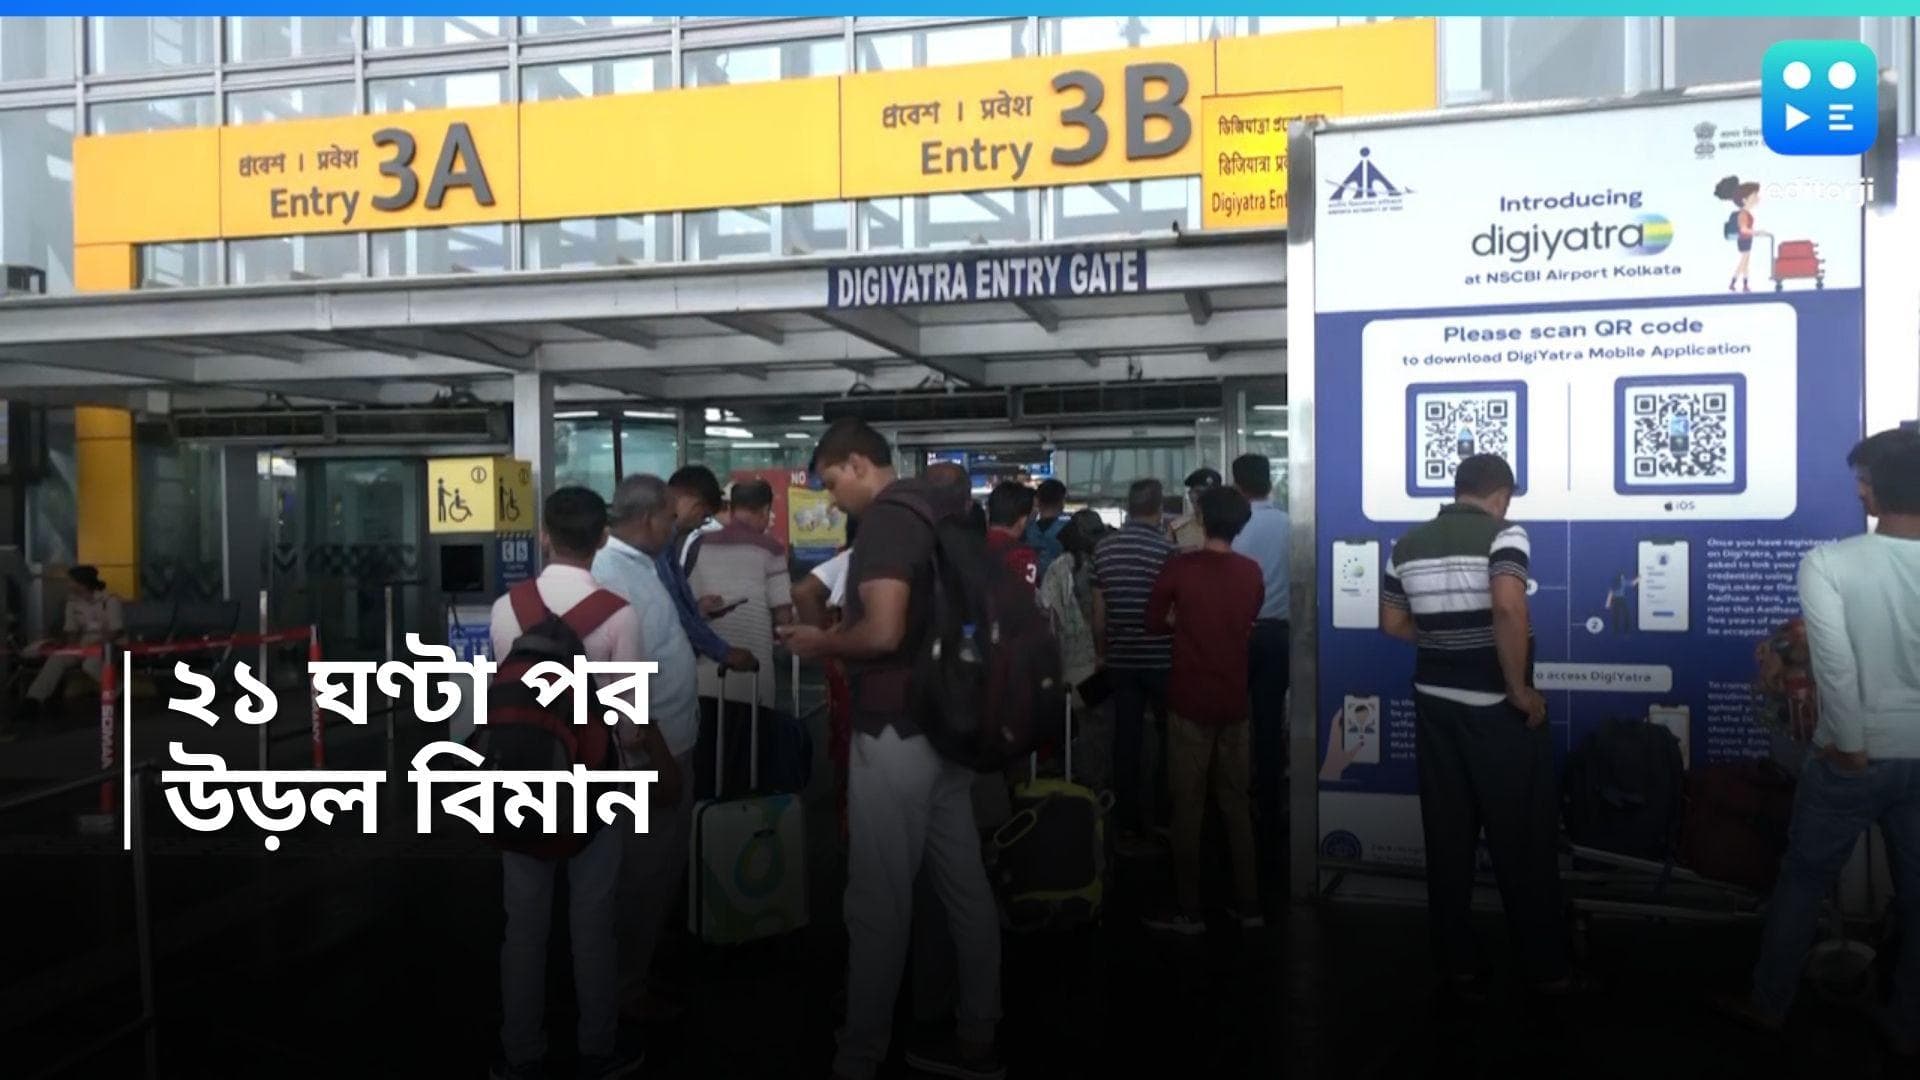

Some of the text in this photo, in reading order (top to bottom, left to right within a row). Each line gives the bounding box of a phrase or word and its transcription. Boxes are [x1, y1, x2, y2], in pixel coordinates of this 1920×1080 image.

[882, 101, 940, 128] প্রবেশ
[981, 91, 1033, 121] प्रवेश
[1051, 62, 1192, 167] 3B
[239, 152, 286, 178] প্রবেশ
[317, 144, 359, 170] प्रवेश
[371, 122, 496, 213] 3A
[921, 137, 1033, 181] Entry
[270, 185, 360, 225] Entry
[1211, 192, 1266, 217] Digiyatra
[1500, 189, 1643, 212] Introducing
[1472, 221, 1644, 263] digiyatra
[838, 251, 1138, 307] DIGIYATRA ENTRY GATE
[1465, 264, 1682, 285] at NSCBI Airport Kolkata
[1444, 318, 1704, 342] Please scan QR code
[1402, 344, 1751, 366] to download DigiYatra Mobile Application
[791, 471, 806, 485] NO
[1675, 500, 1696, 511] iOS
[1546, 671, 1587, 681] access
[1590, 670, 1651, 684] DigiYatra
